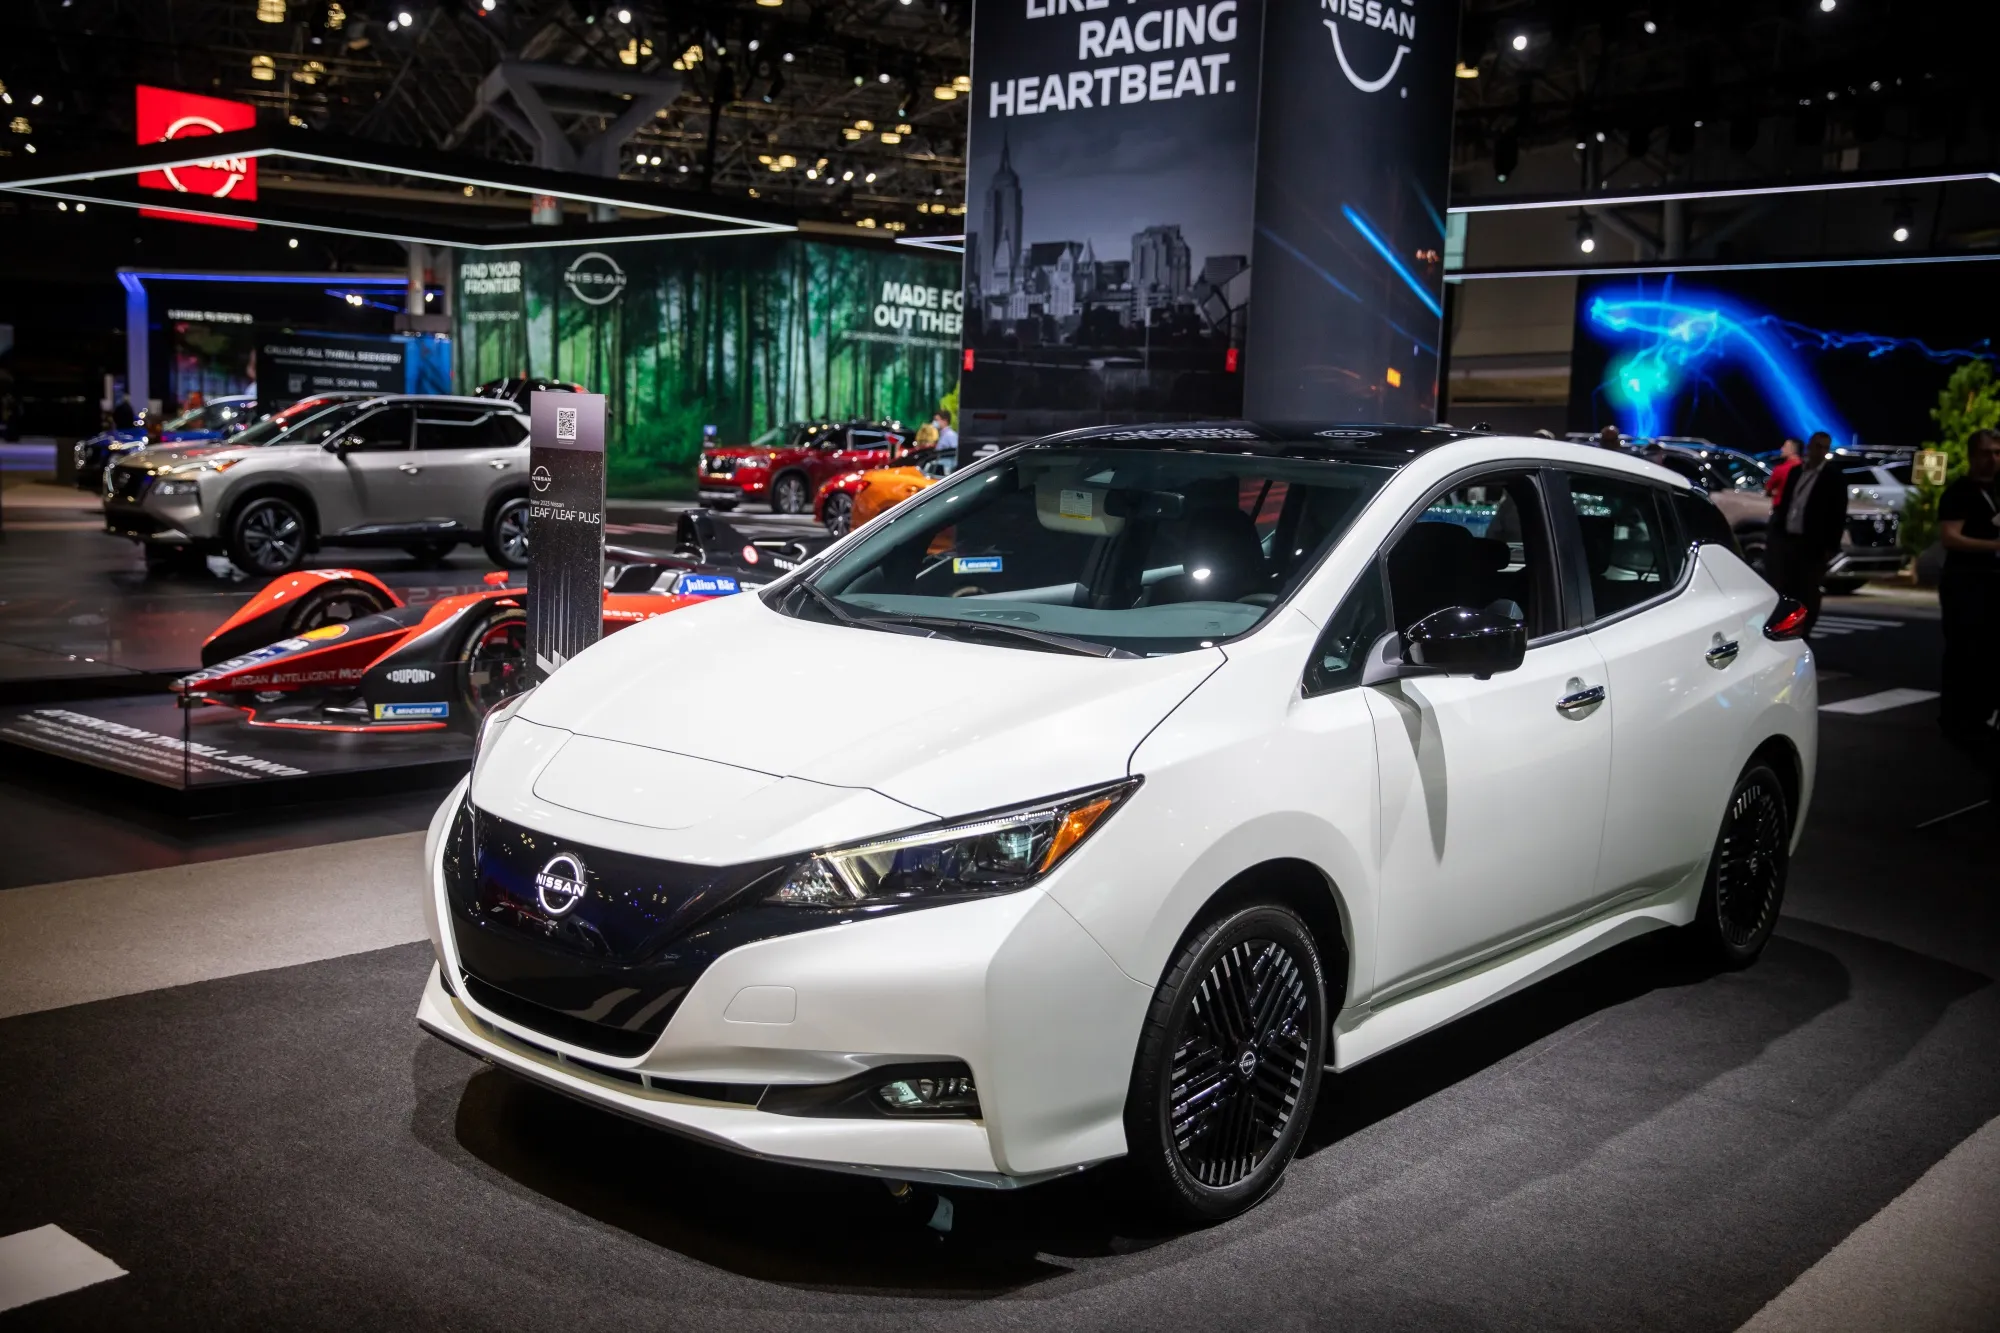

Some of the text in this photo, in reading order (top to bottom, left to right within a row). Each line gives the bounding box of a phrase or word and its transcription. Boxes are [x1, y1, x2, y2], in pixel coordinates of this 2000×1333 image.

[1079, 1, 1238, 60] RACING
[989, 52, 1236, 118] HEARTBEAT.
[461, 261, 521, 279] FIND YOUR
[564, 271, 627, 286] NISSAN
[464, 277, 521, 295] FRONTIER
[882, 280, 963, 313] MADE FO
[874, 304, 916, 330] OUT
[578, 512, 600, 524] PLUS
[686, 579, 716, 592] Julius
[231, 675, 268, 687] NISSAN
[536, 873, 585, 897] NISSAN
